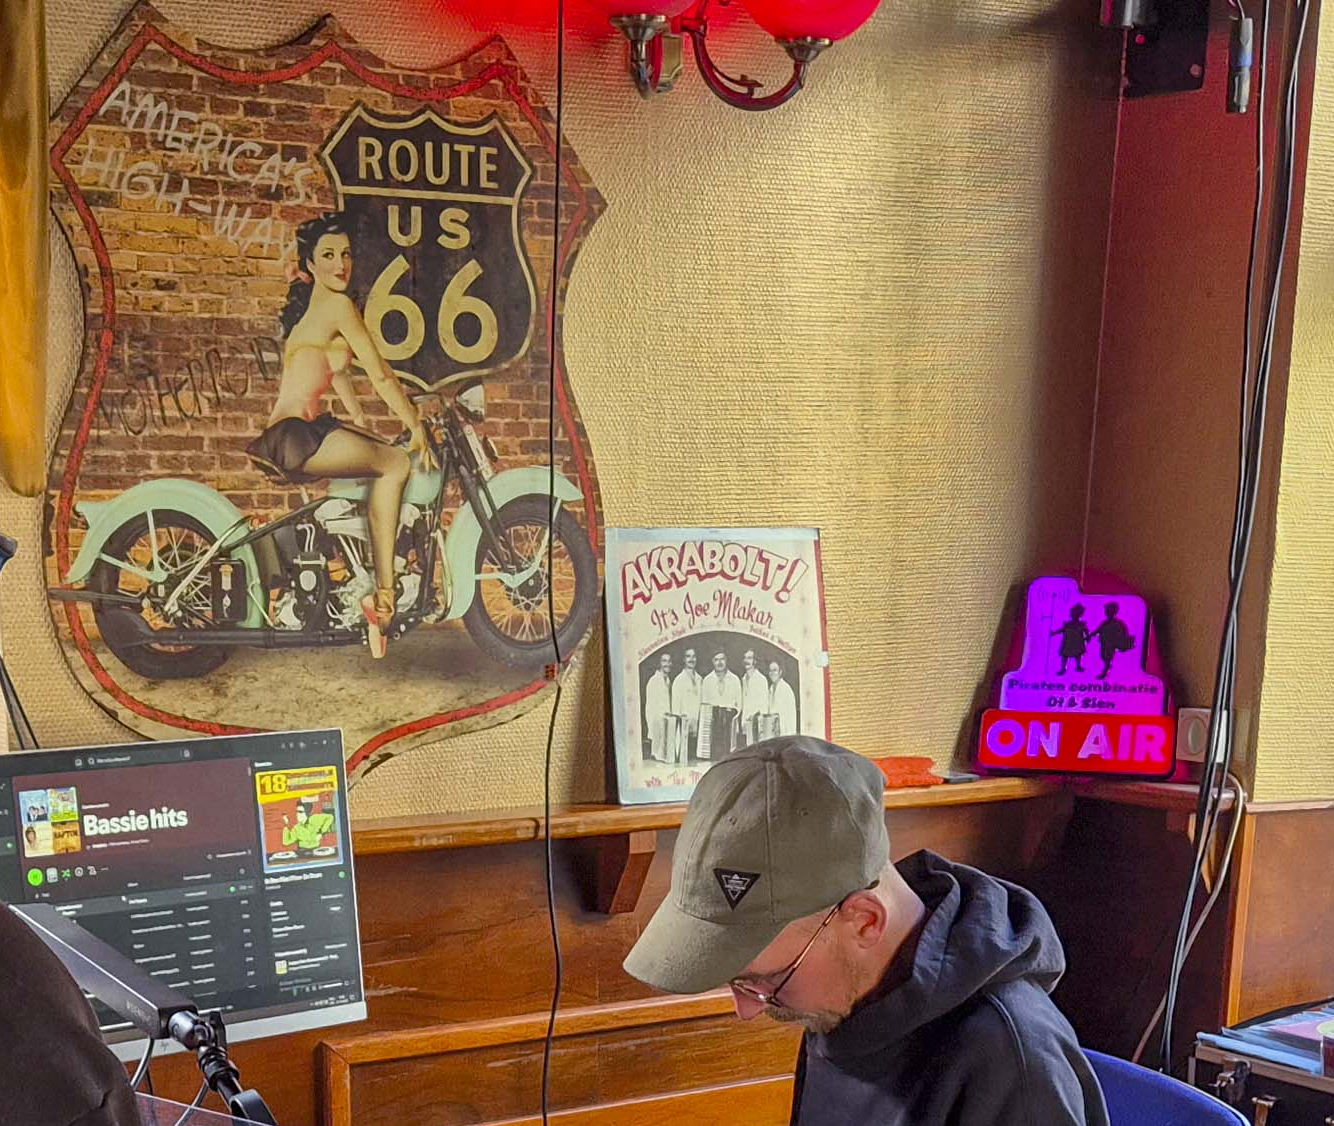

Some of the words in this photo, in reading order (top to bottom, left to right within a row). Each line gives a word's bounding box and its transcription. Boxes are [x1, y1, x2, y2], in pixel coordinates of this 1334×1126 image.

[99, 81, 314, 204] AMERICA'S
[357, 136, 499, 189] ROUTE
[387, 204, 471, 250] US
[364, 254, 498, 364] 66
[622, 540, 809, 613] AKRABOLT!
[651, 608, 679, 634] It's
[683, 591, 710, 629] Joe
[986, 718, 1063, 758] ON
[1077, 723, 1167, 763] AIR
[83, 810, 149, 837] Bassie
[149, 806, 189, 830] hits
